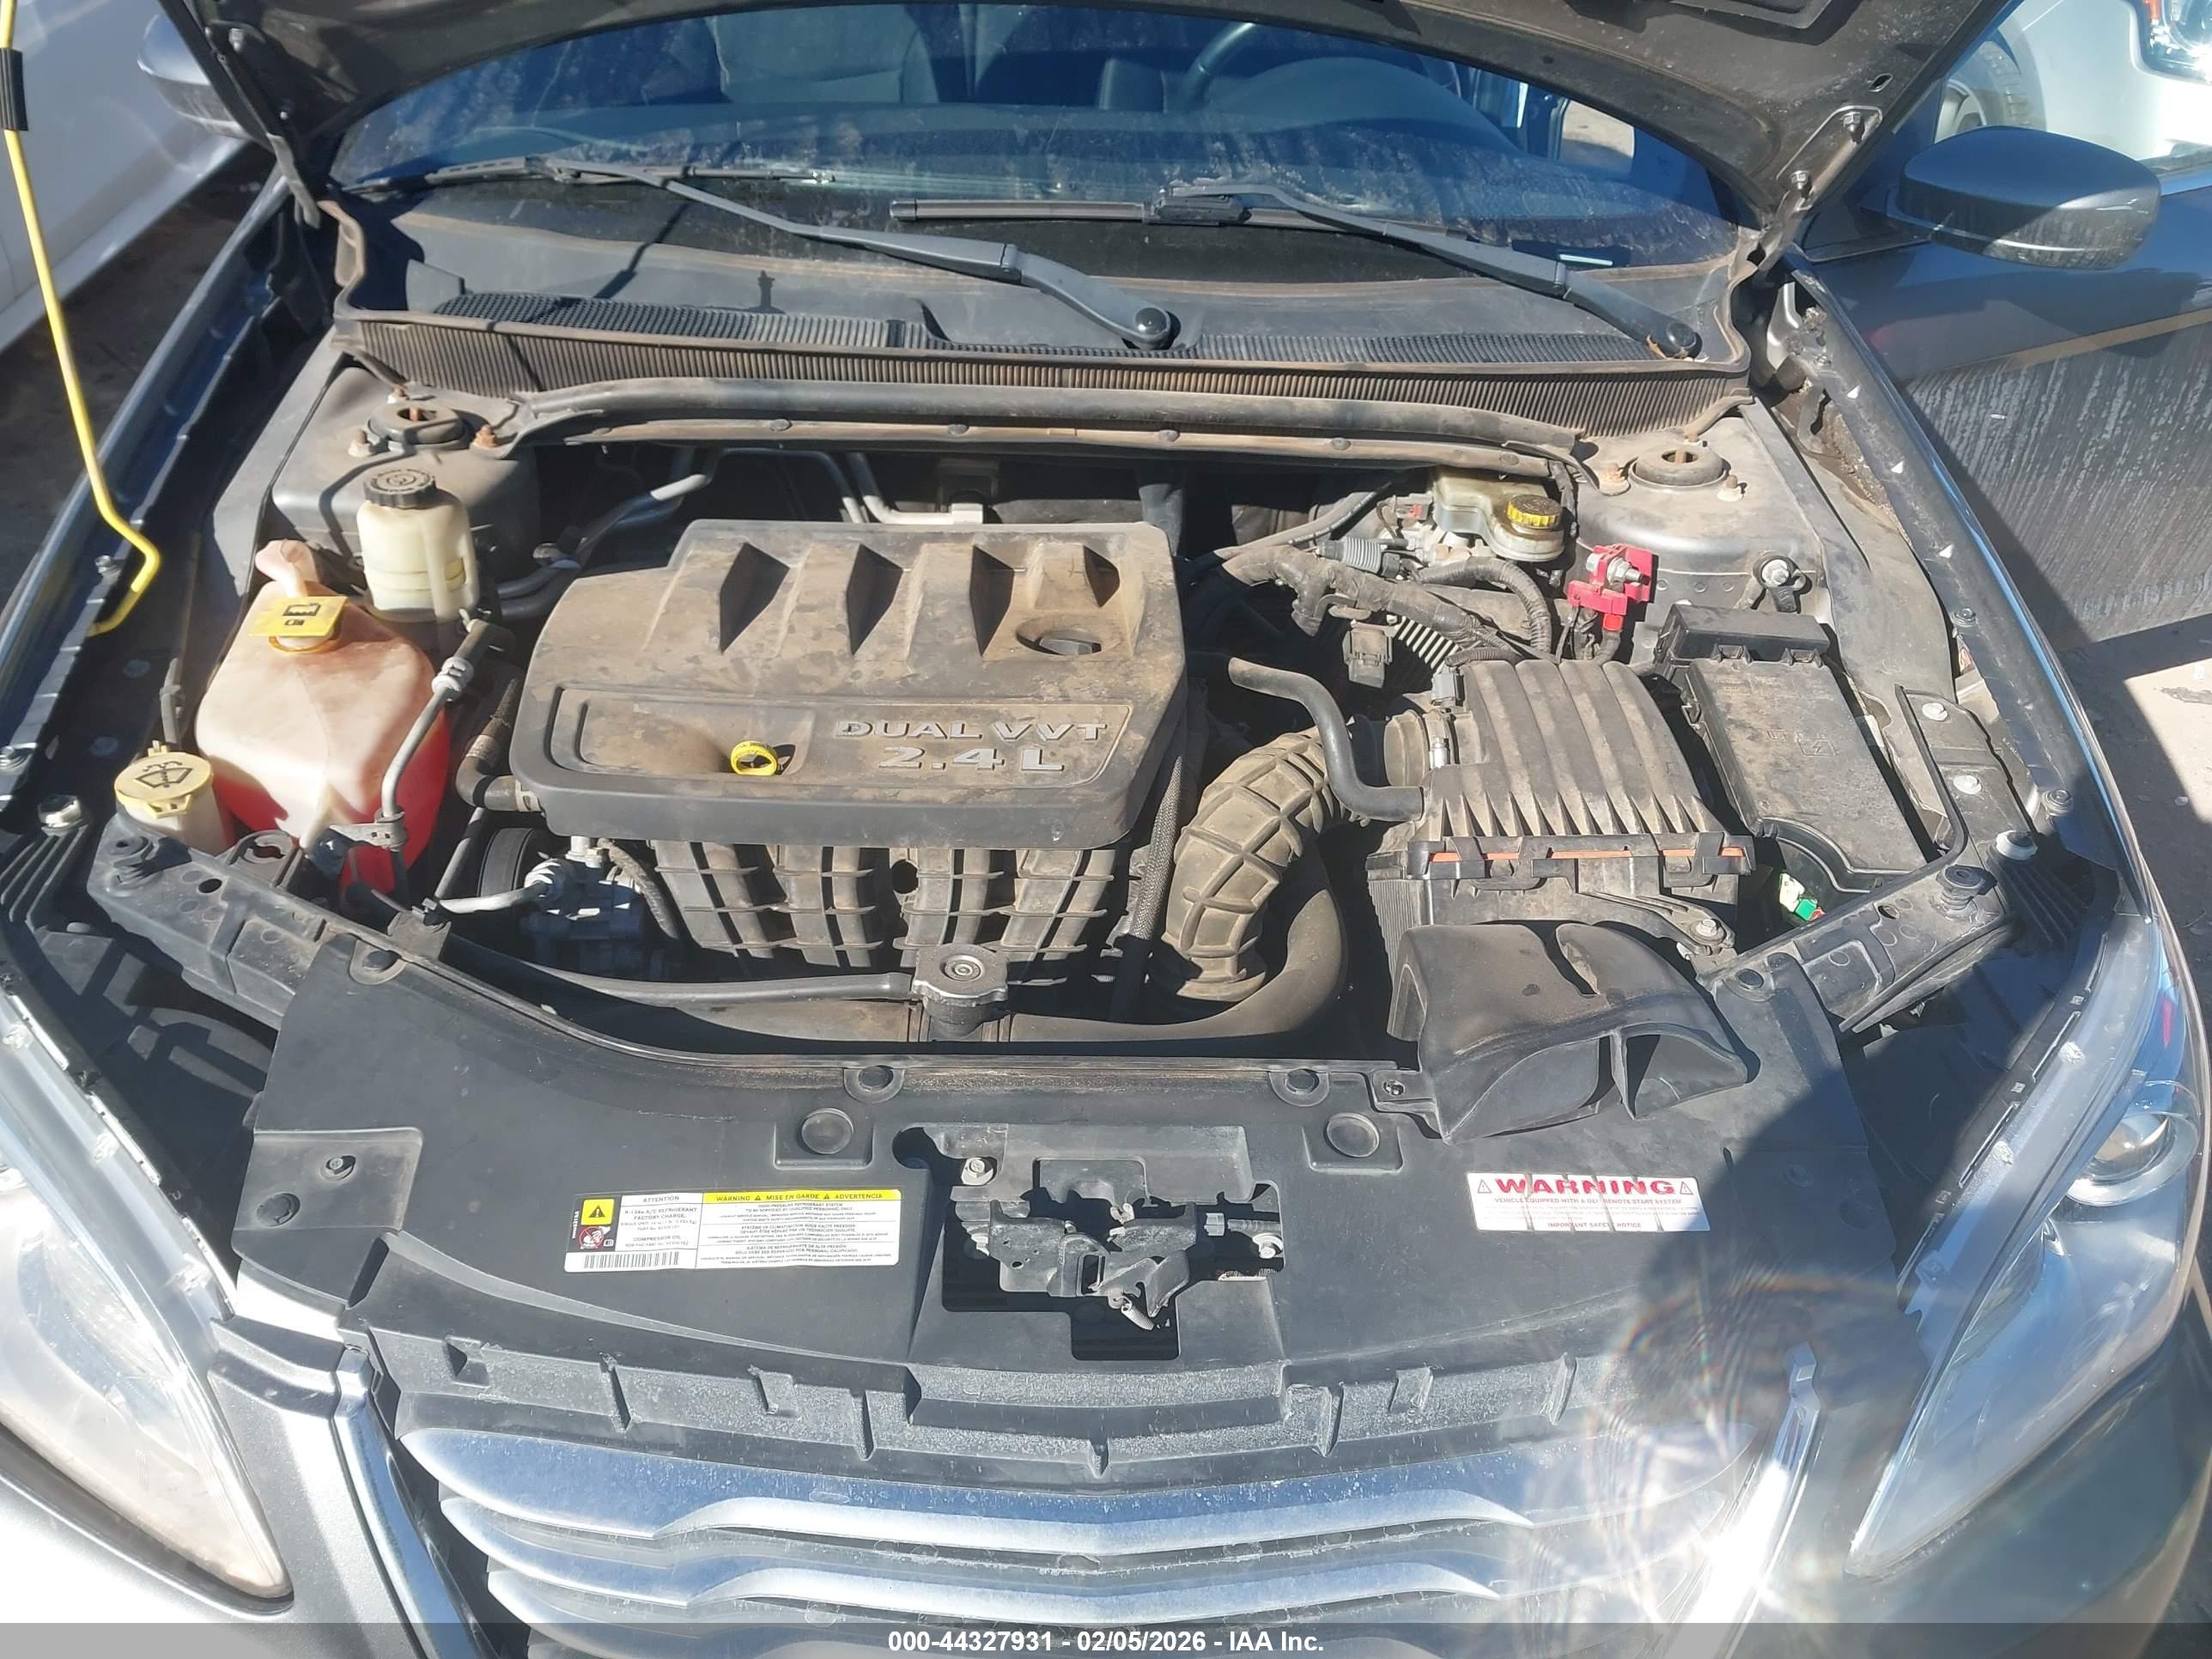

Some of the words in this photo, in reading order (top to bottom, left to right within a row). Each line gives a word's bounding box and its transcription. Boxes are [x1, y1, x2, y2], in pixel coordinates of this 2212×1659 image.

[836, 720, 983, 739] DUAL
[994, 721, 1108, 741] VVT
[1495, 1179, 1675, 1195] WARNING
